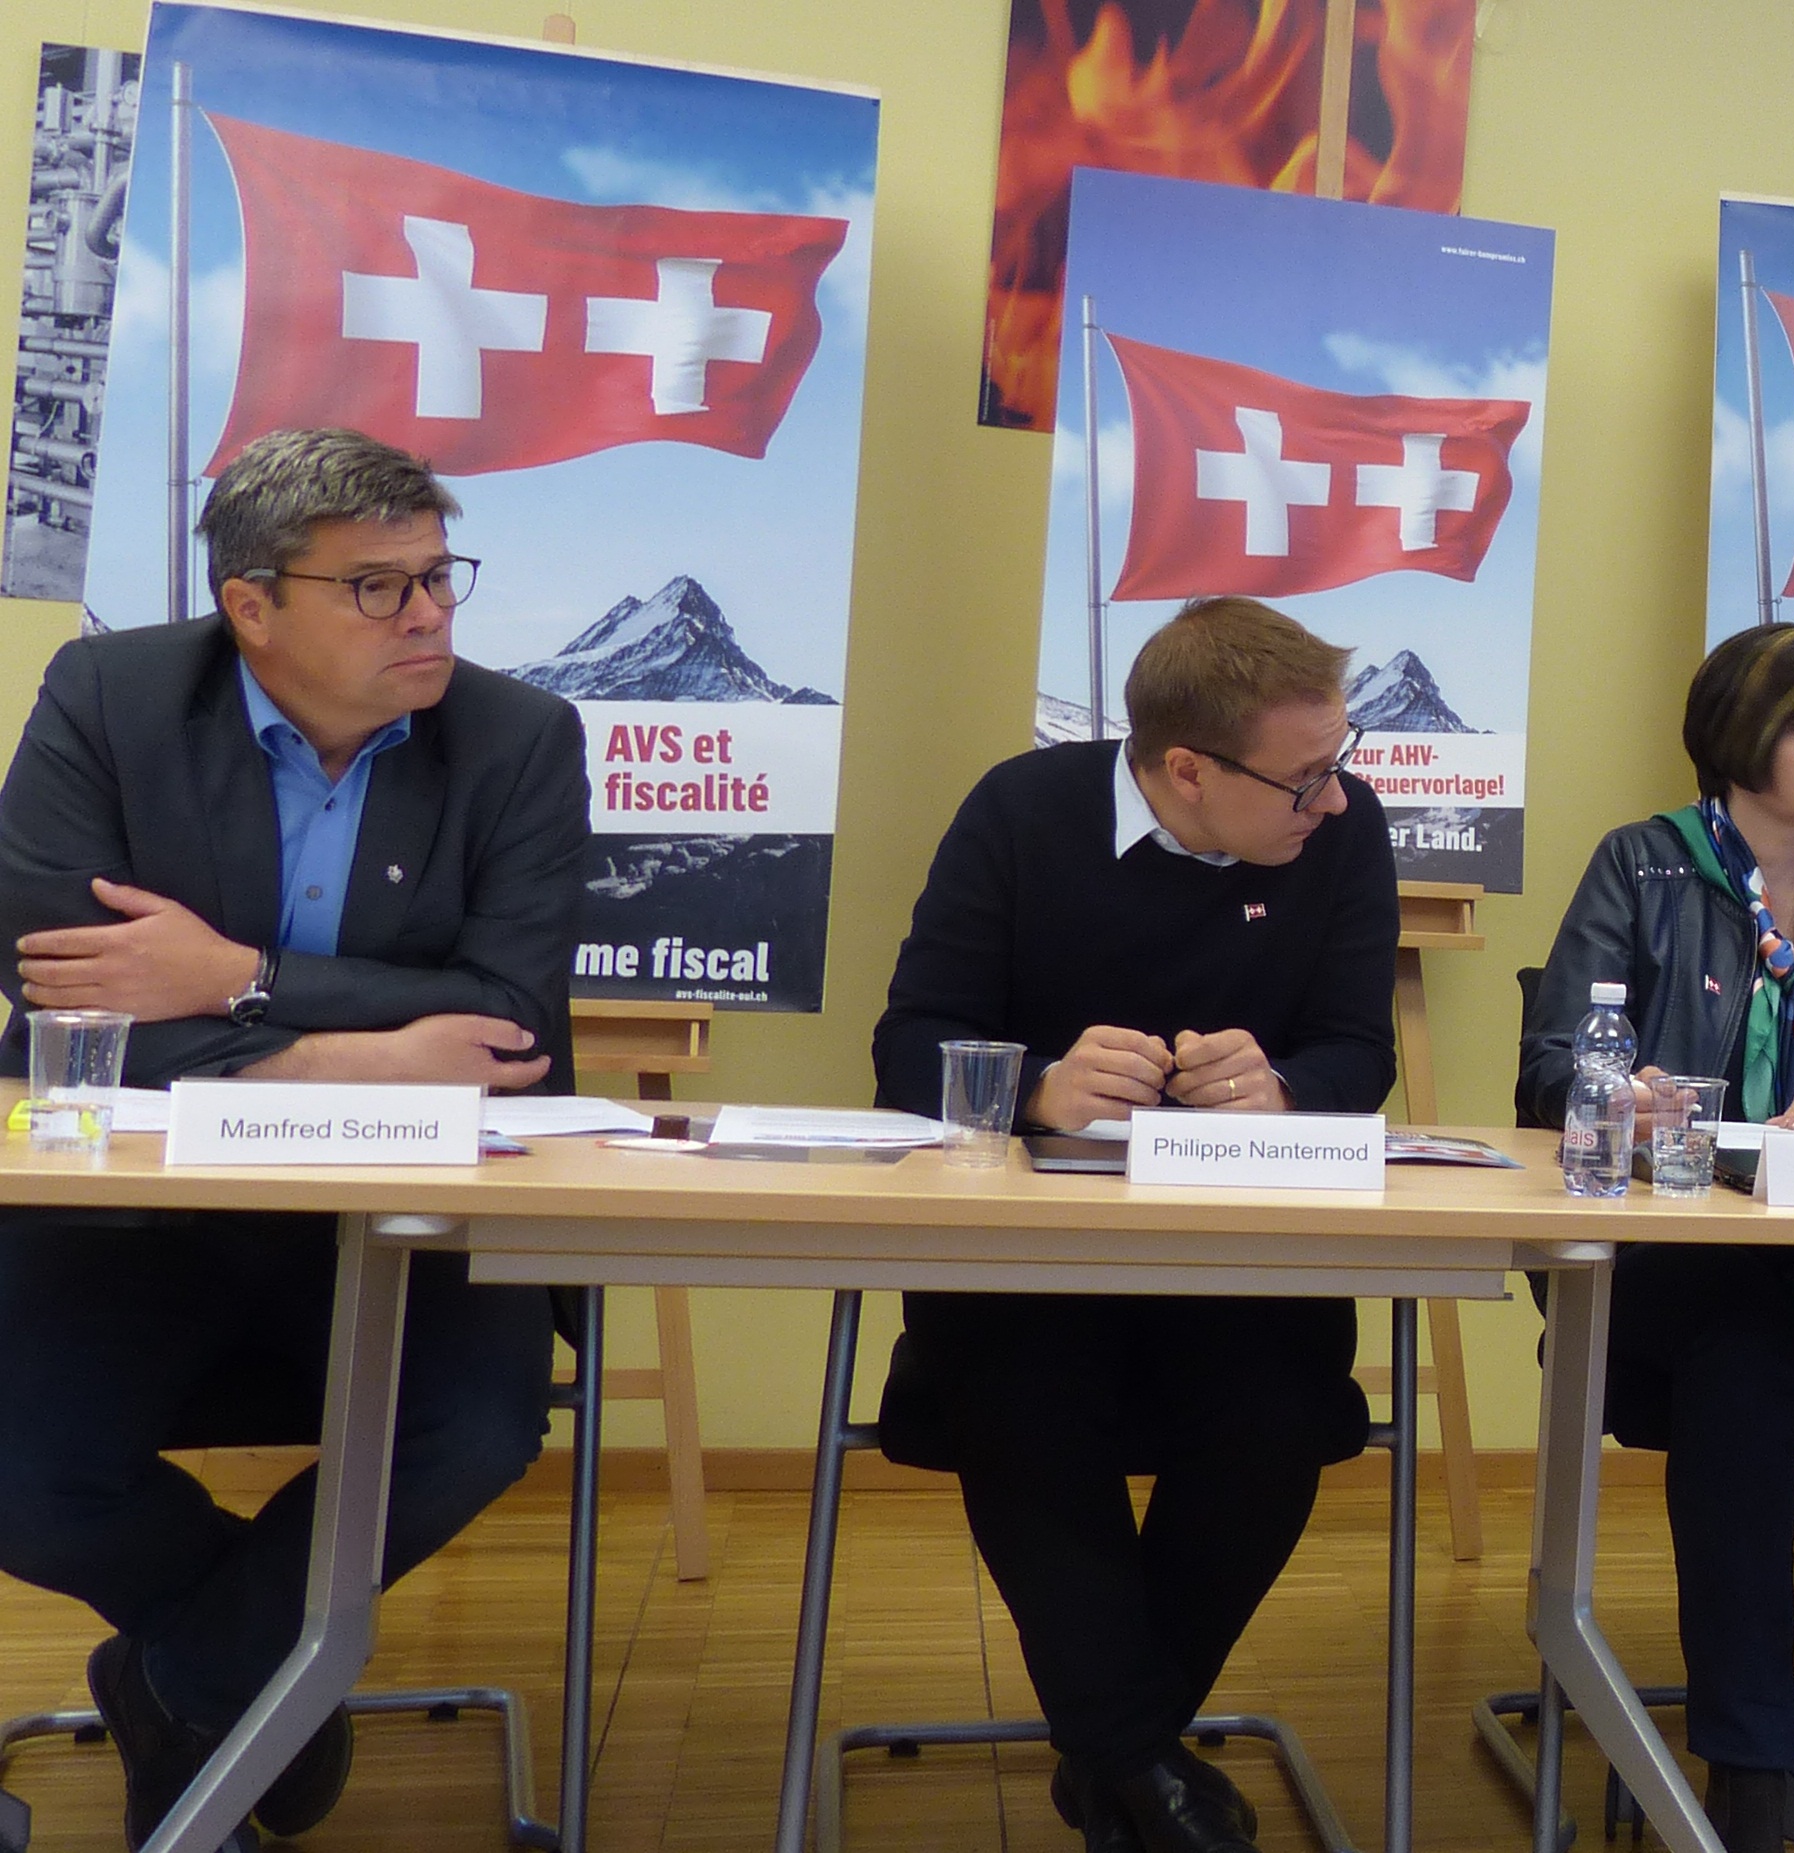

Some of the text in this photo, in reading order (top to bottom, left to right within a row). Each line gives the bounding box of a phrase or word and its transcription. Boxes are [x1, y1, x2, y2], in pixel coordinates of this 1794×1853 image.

[605, 725, 732, 764] AVS et
[1351, 744, 1439, 766] zur AHV-
[605, 772, 769, 812] fiscalité
[1388, 824, 1482, 852] er Land.
[575, 937, 769, 982] me fiscal
[221, 1118, 438, 1139] Manfred Schmid
[1154, 1138, 1368, 1161] Philippe Nantermod
